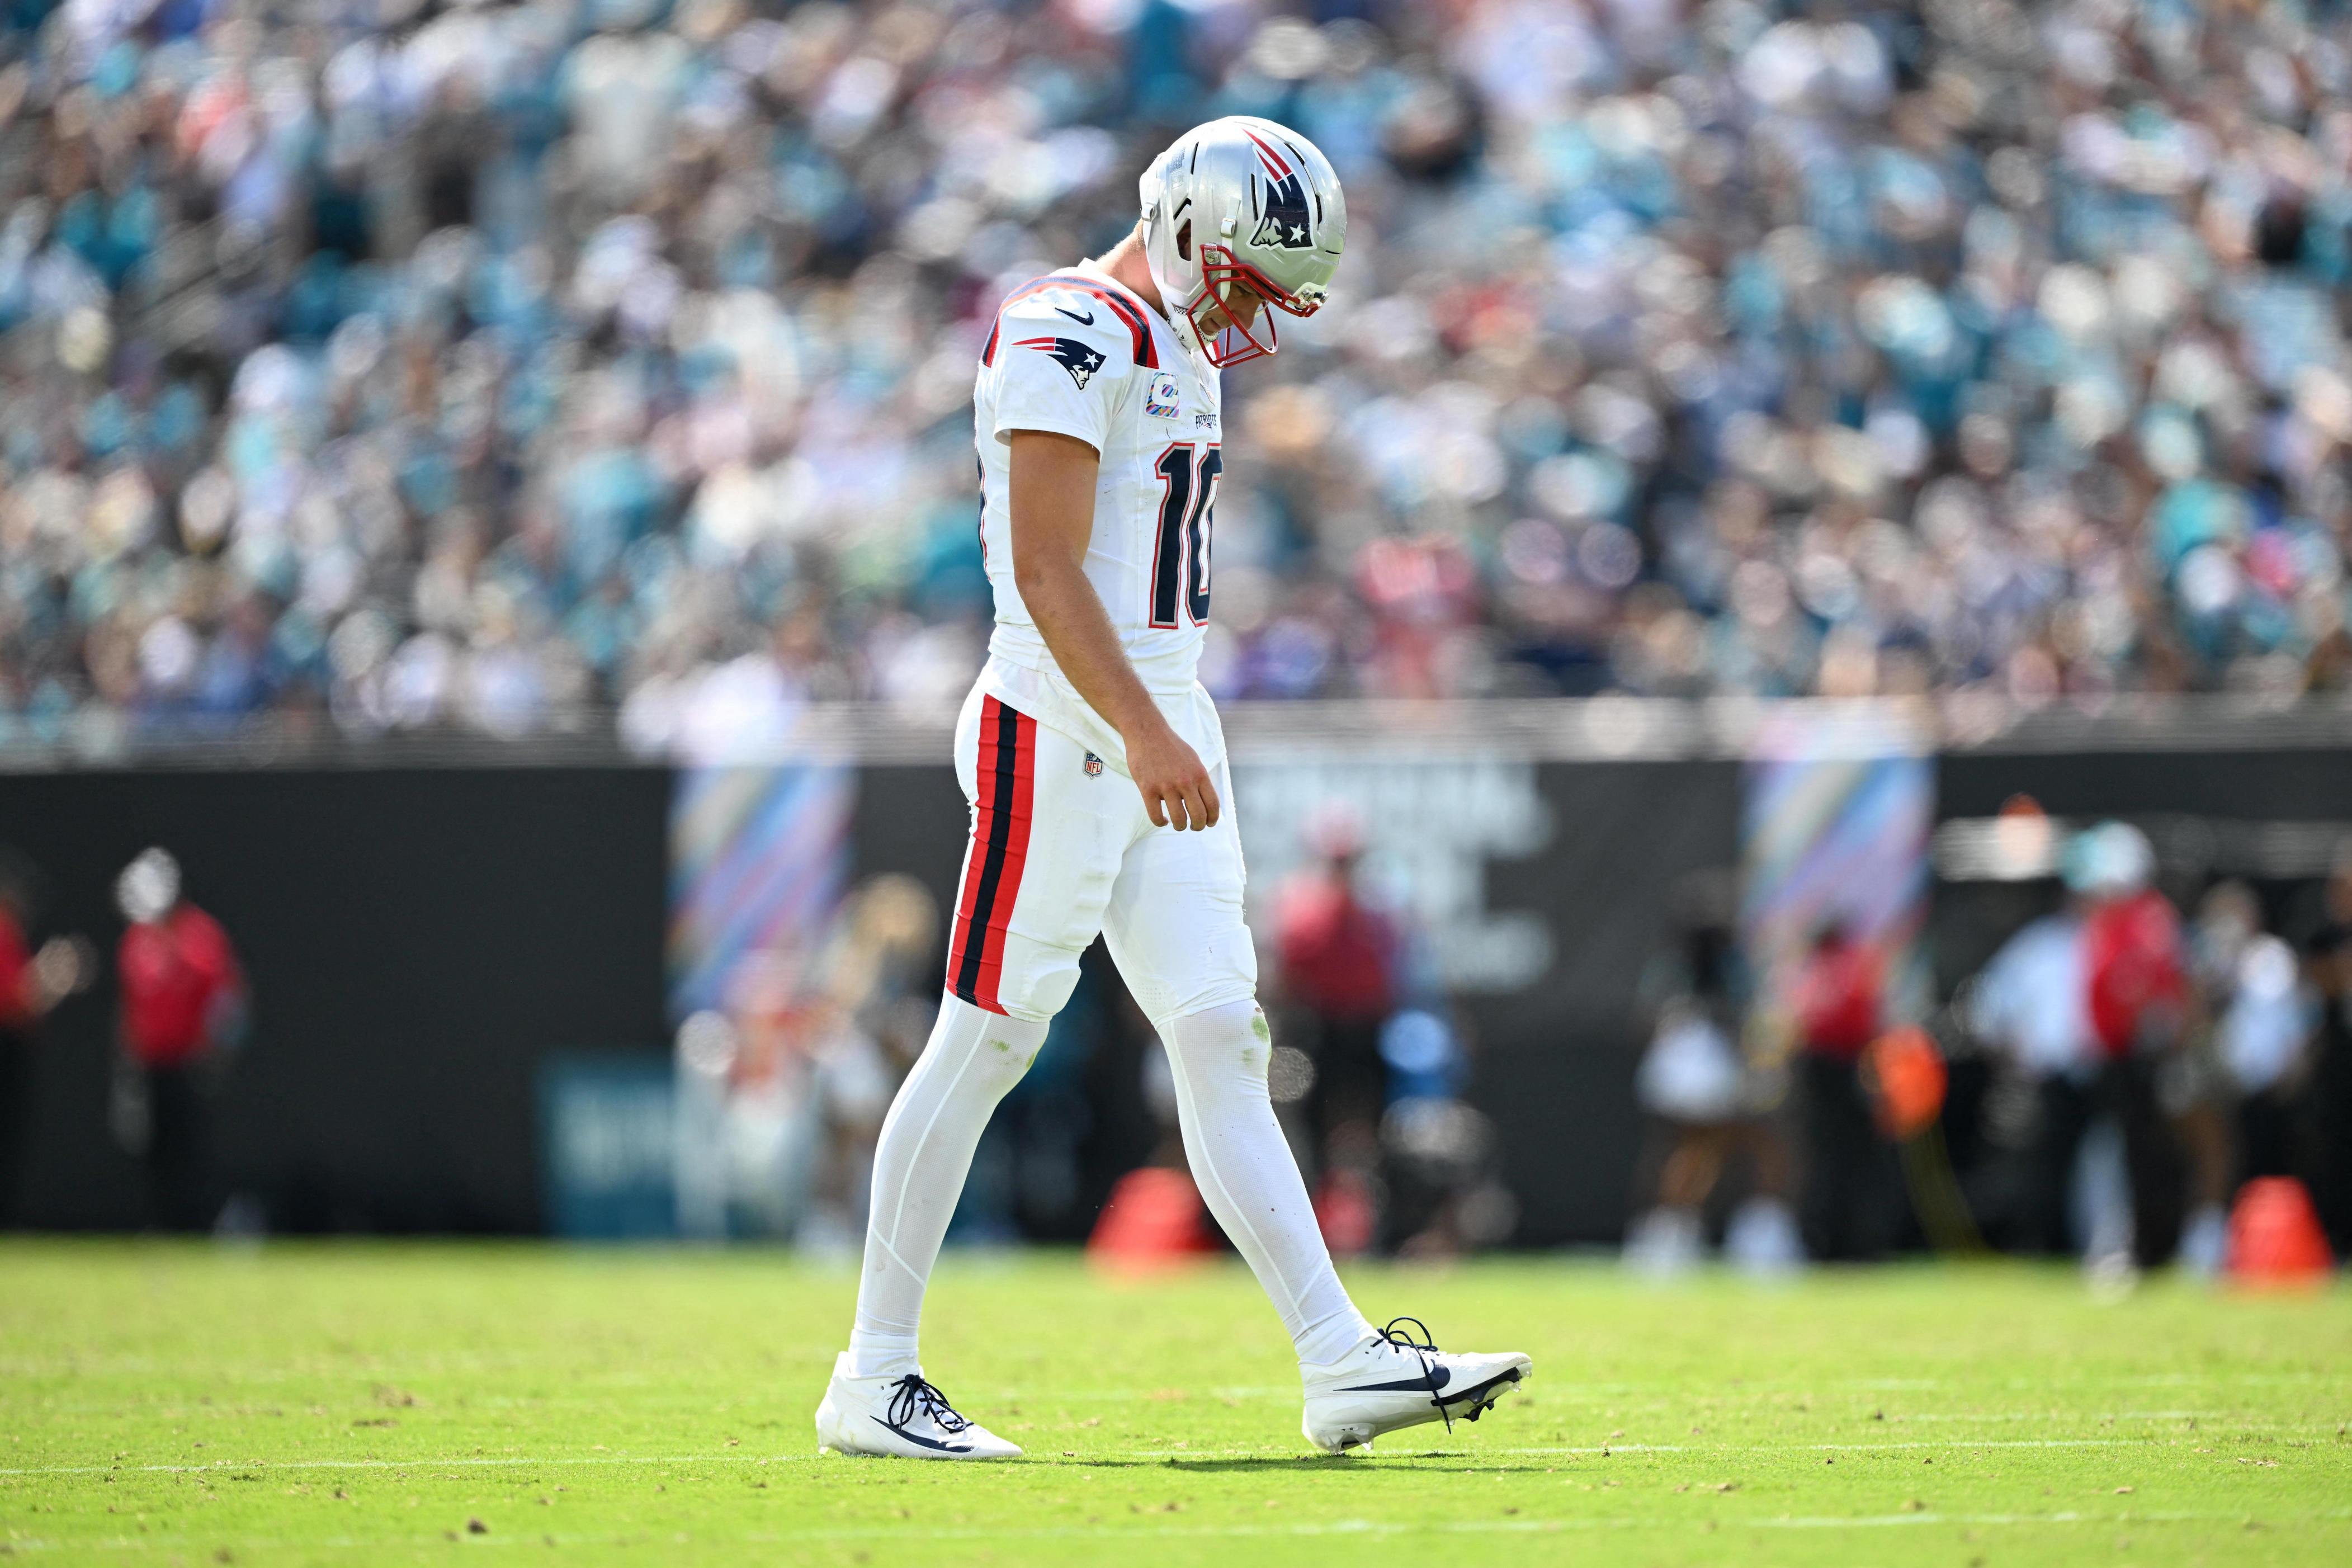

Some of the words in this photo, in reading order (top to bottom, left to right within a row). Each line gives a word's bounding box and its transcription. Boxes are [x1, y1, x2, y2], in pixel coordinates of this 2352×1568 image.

[1196, 414, 1217, 429] PATRIOTS
[1149, 442, 1224, 630] 10
[1087, 761, 1101, 773] NFL
